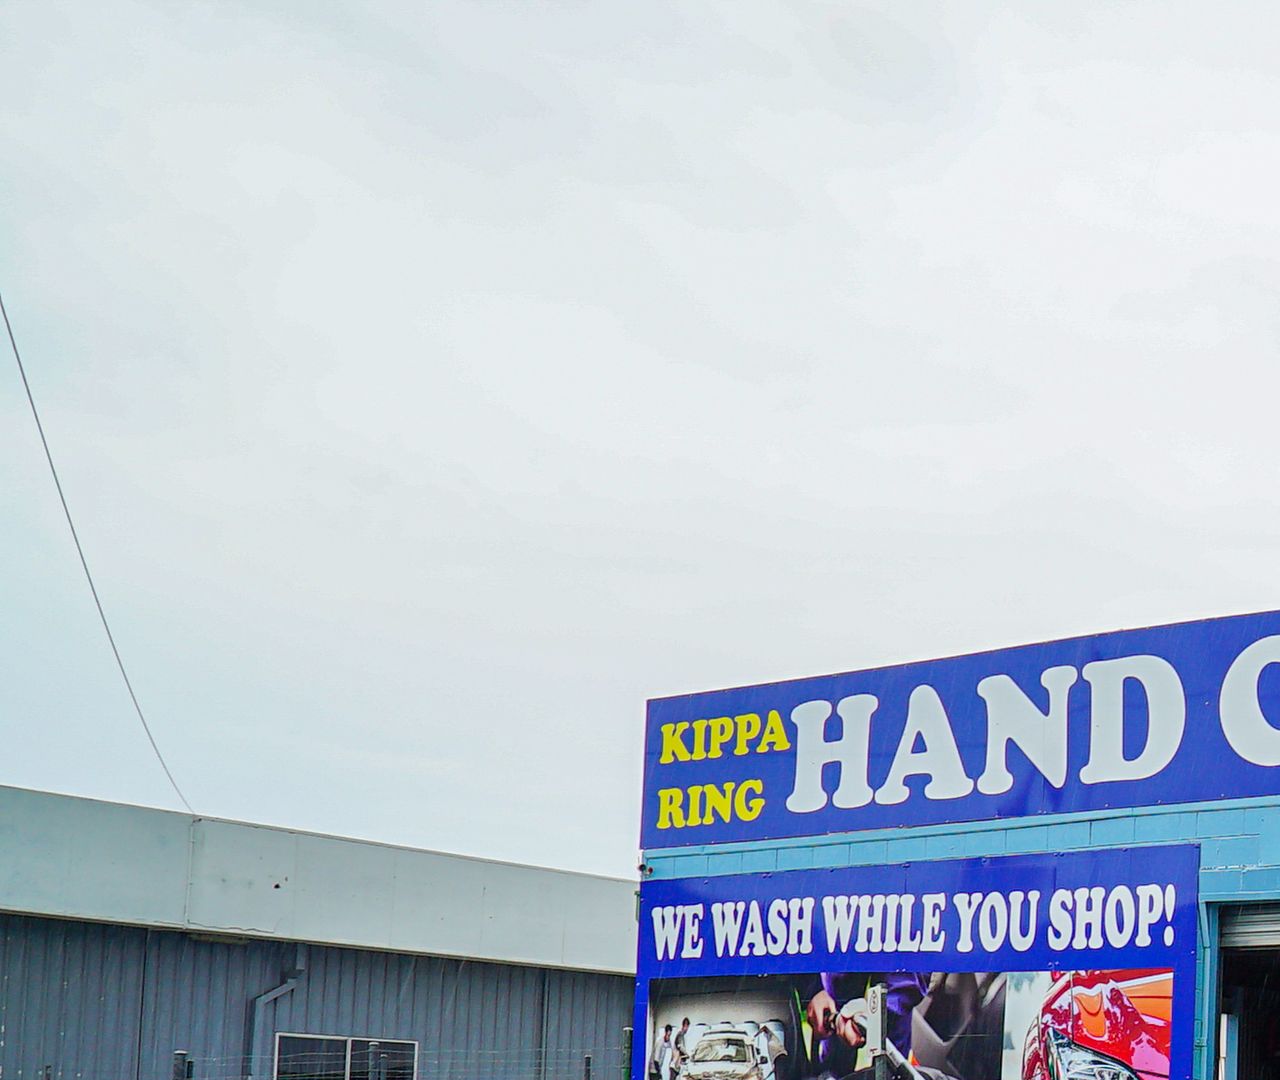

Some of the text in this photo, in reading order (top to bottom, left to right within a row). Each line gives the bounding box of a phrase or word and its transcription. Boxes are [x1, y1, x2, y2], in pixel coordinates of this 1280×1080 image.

[658, 709, 791, 764] KIPPA
[786, 655, 1186, 814] HAND
[656, 779, 765, 829] RING
[652, 884, 1175, 960] WE WASH WHILE YOU SHOP!
